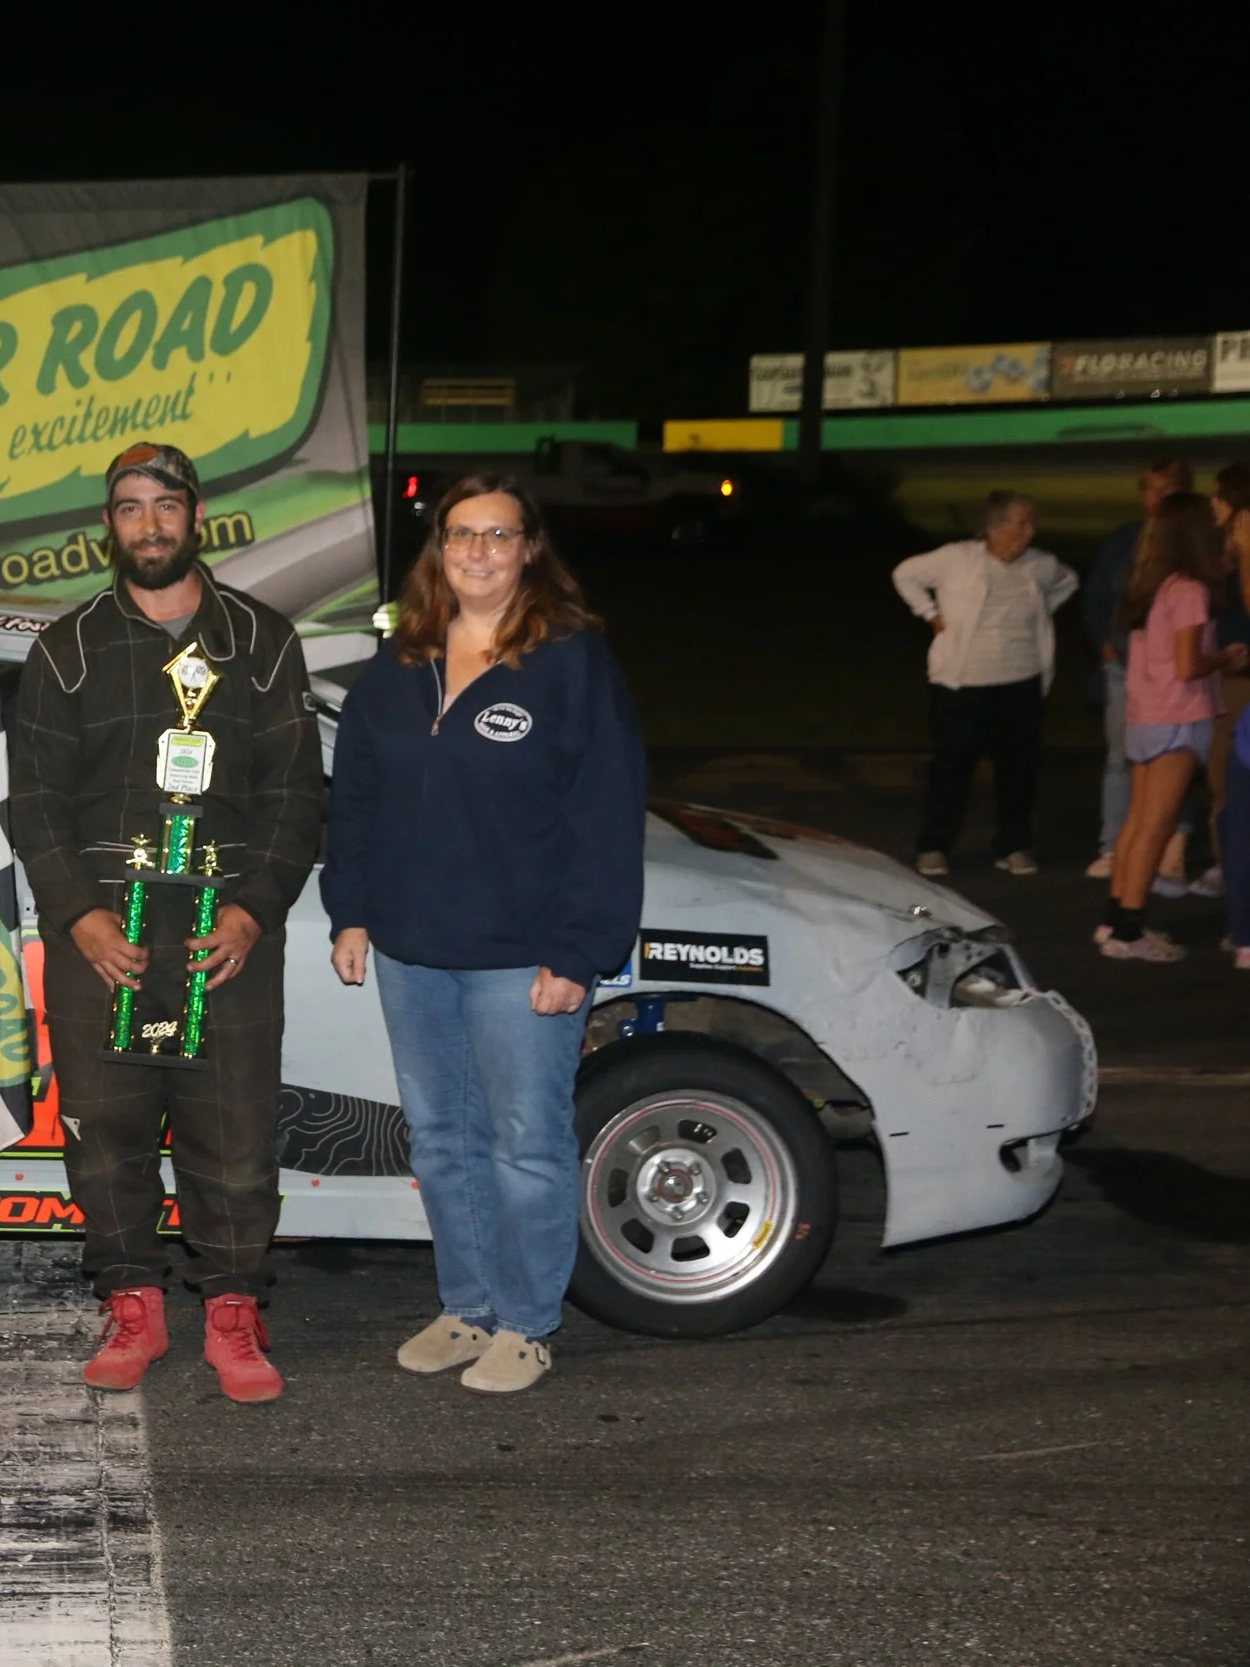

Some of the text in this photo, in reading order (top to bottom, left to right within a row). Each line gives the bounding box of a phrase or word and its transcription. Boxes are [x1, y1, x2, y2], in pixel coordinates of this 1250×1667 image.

[38, 263, 275, 396] ROAD
[481, 710, 528, 731] Lenny's
[649, 942, 765, 966] REYNOLDS
[141, 1020, 178, 1038] 2024
